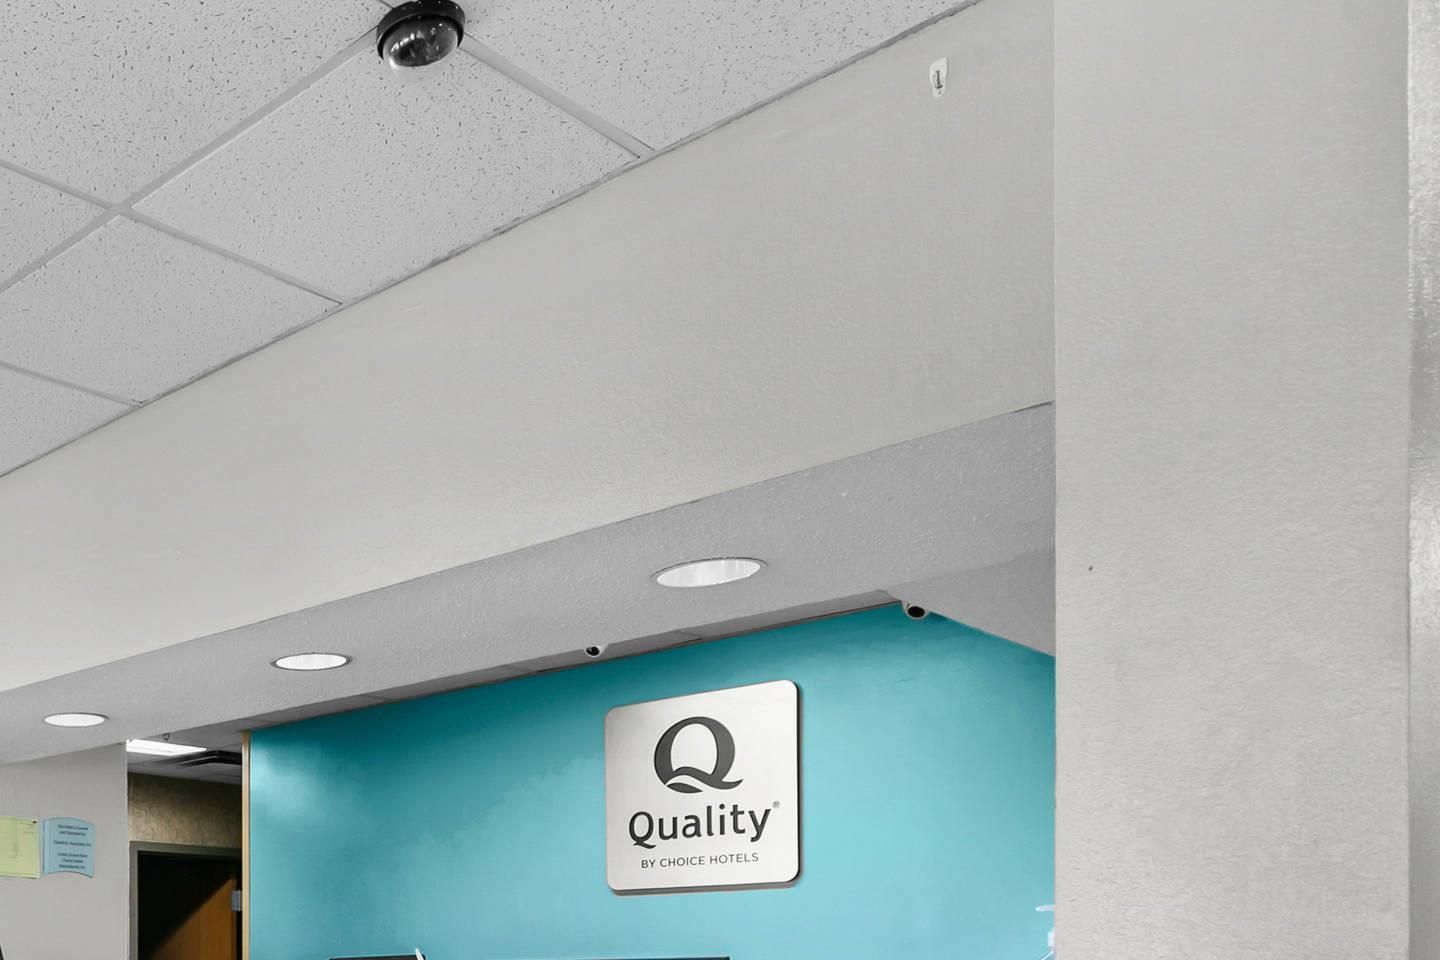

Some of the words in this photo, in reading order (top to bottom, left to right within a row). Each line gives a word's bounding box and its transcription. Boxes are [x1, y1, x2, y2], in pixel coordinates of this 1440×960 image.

[629, 803, 771, 849] Quality
[641, 857, 657, 870] BY
[659, 856, 706, 869] CHOICE
[709, 852, 759, 865] HOTELS
